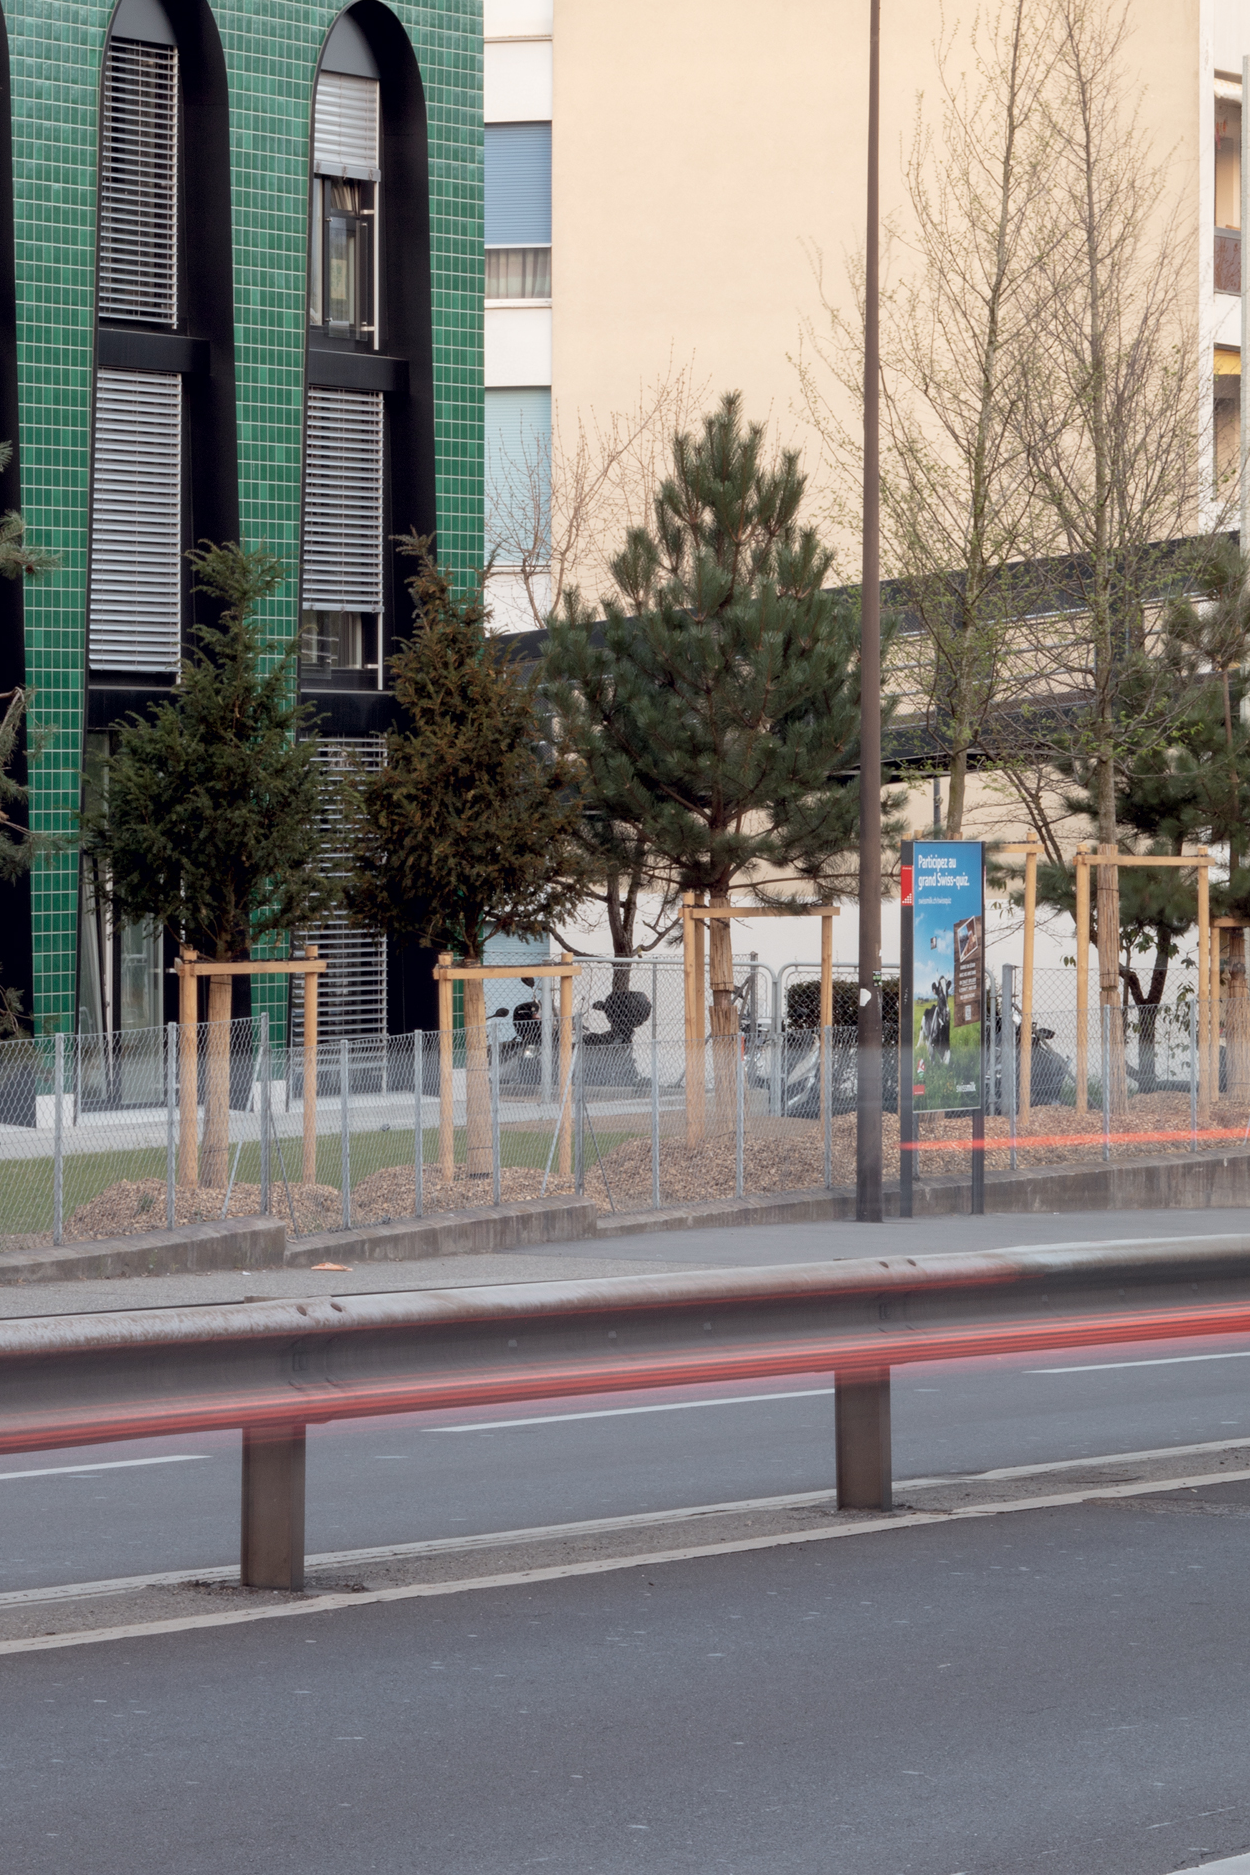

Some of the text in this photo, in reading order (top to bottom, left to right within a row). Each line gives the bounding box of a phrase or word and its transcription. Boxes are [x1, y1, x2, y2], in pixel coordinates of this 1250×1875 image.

[918, 854, 956, 872] Participez au
[918, 872, 970, 890] grand Swiss-quiz.
